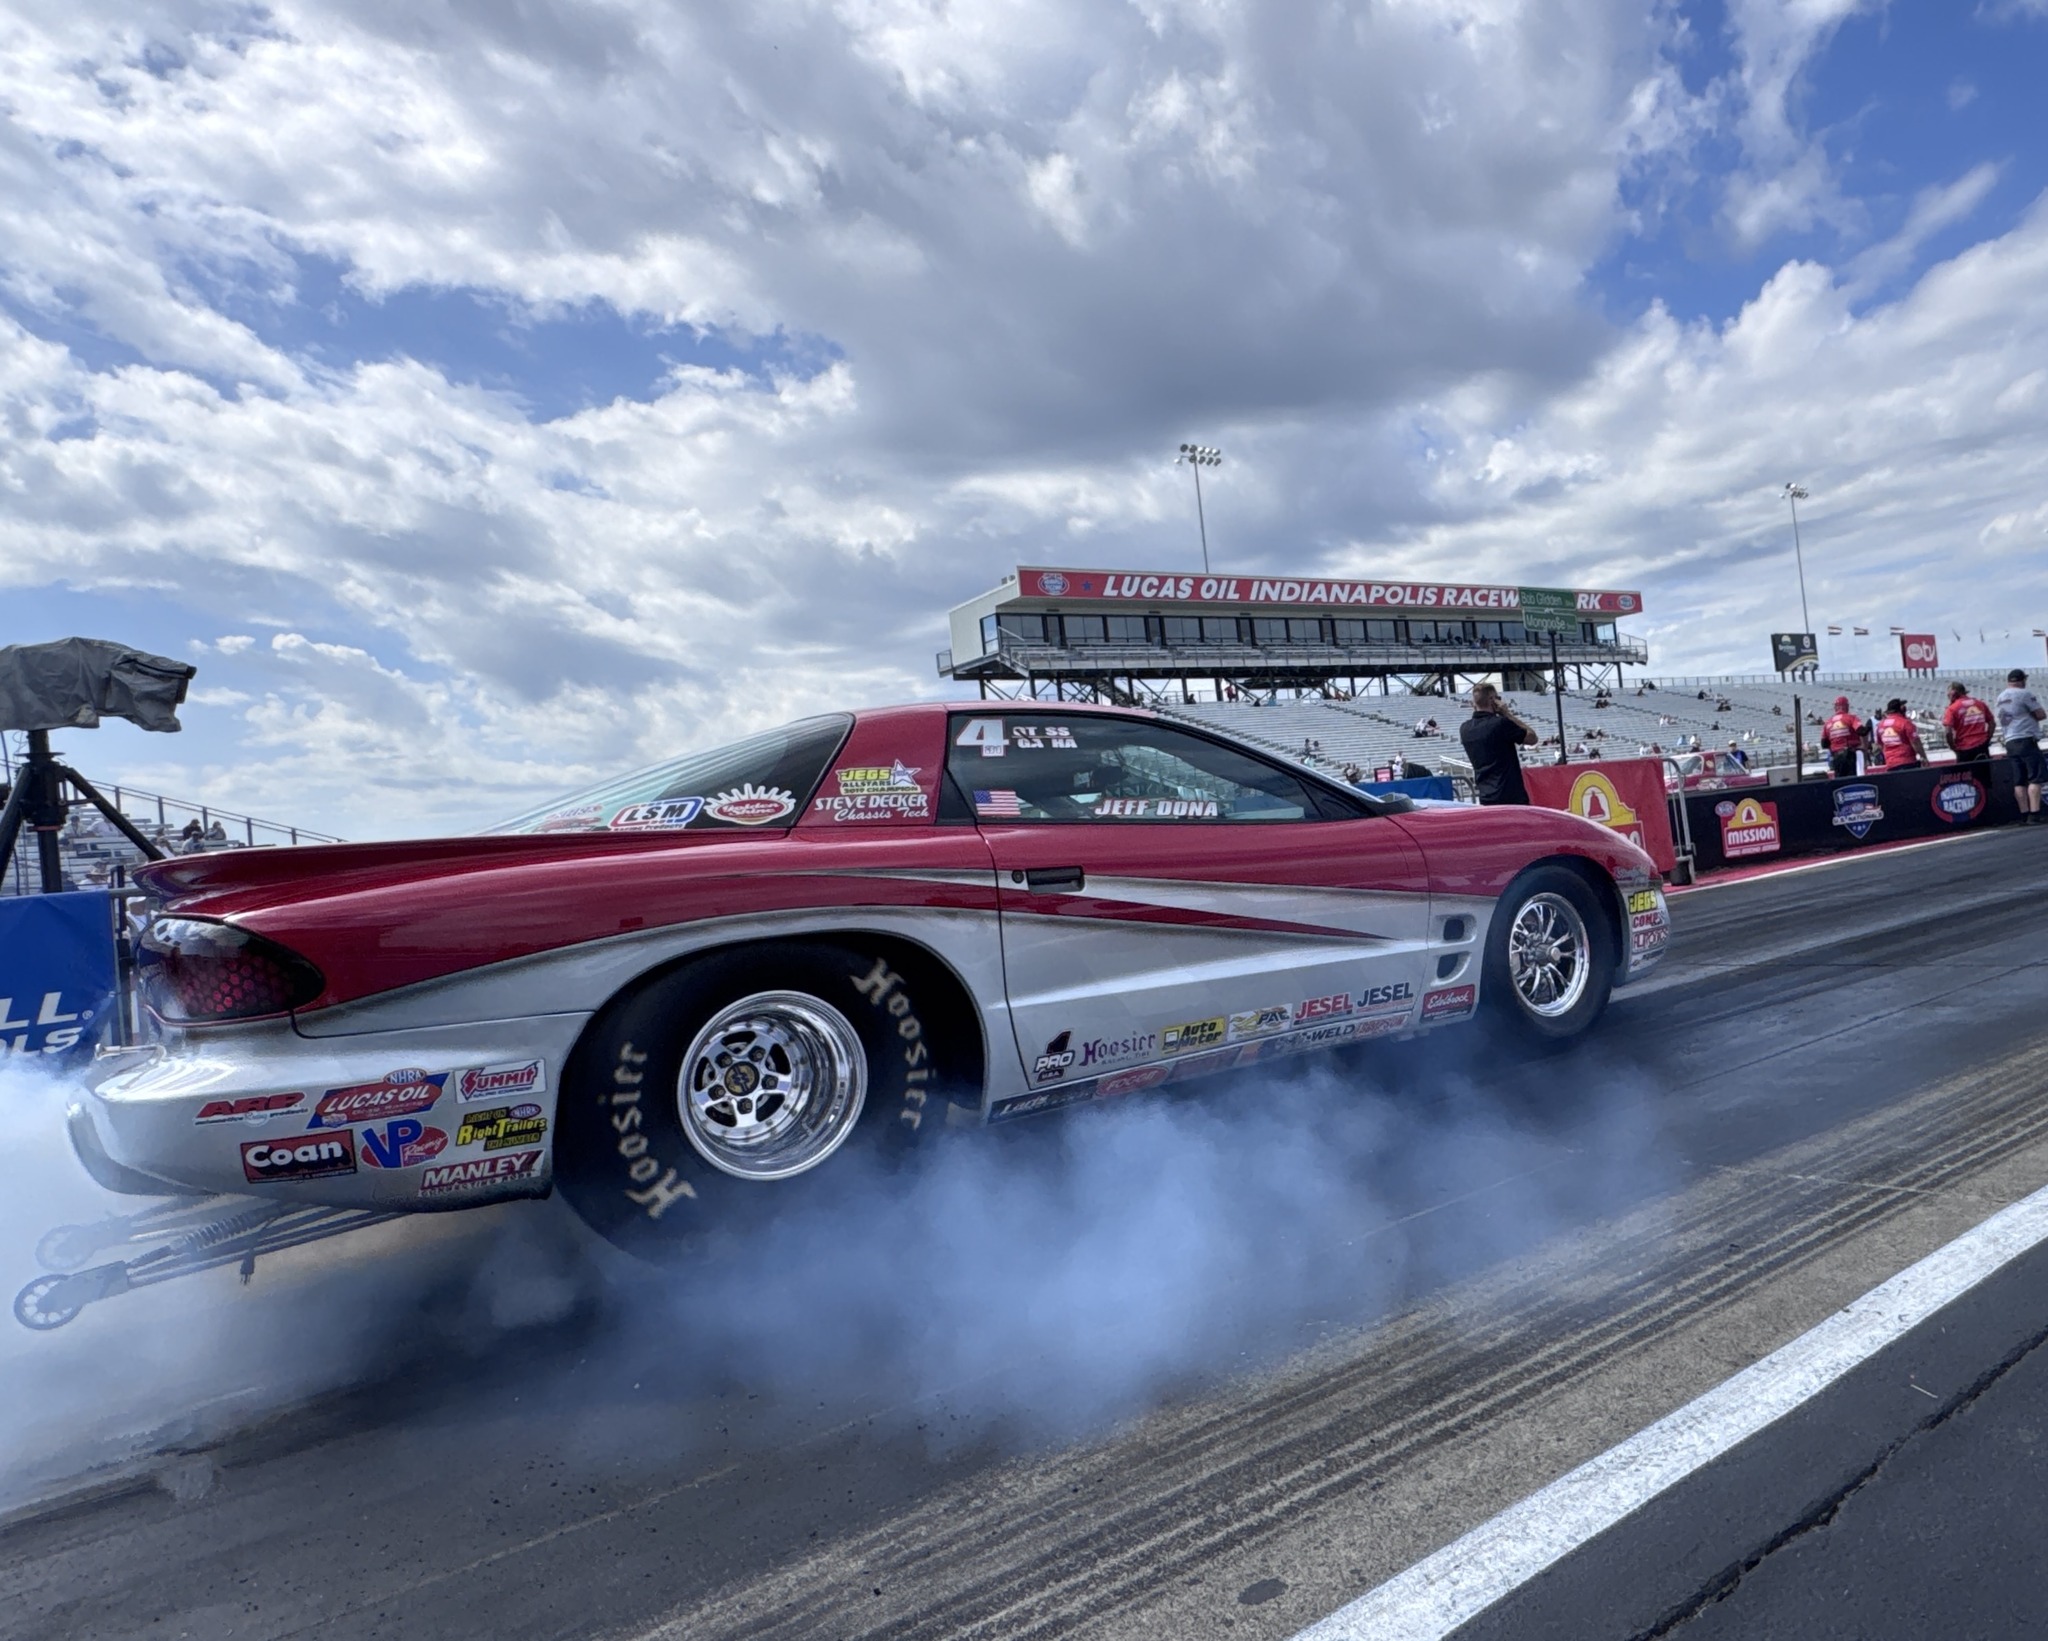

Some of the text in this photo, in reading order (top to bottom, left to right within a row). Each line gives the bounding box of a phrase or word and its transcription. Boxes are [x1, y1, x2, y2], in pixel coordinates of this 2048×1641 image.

[1103, 575, 1194, 599] LUCAS
[1200, 578, 1240, 600] OIL
[1249, 581, 1438, 605] INDIANAPOLIS
[1441, 588, 1519, 608] RACEW
[1576, 593, 1603, 610] RK
[956, 719, 1010, 757] 4
[1045, 726, 1071, 736] SS
[1050, 739, 1078, 748] HA
[840, 769, 890, 781] JEGS
[842, 780, 891, 788] ALLSTARS
[624, 804, 687, 822] LSM
[814, 794, 928, 811] STEVE DECKER
[1094, 800, 1149, 815] JEFF
[834, 807, 930, 822] Chassis Tech
[1630, 890, 1657, 913] JEGS
[1357, 982, 1414, 1007] JESEL
[1295, 993, 1353, 1019] JESEL
[1182, 1022, 1217, 1037] Auto
[1034, 1051, 1074, 1072] PRO
[389, 1069, 424, 1084] NHRA
[196, 1092, 306, 1118] ARP
[323, 1088, 398, 1113] LUCAS
[398, 1085, 430, 1101] OIL
[362, 1118, 423, 1168] VP
[245, 1140, 344, 1168] Coan
[423, 1153, 529, 1187] MANLEY
